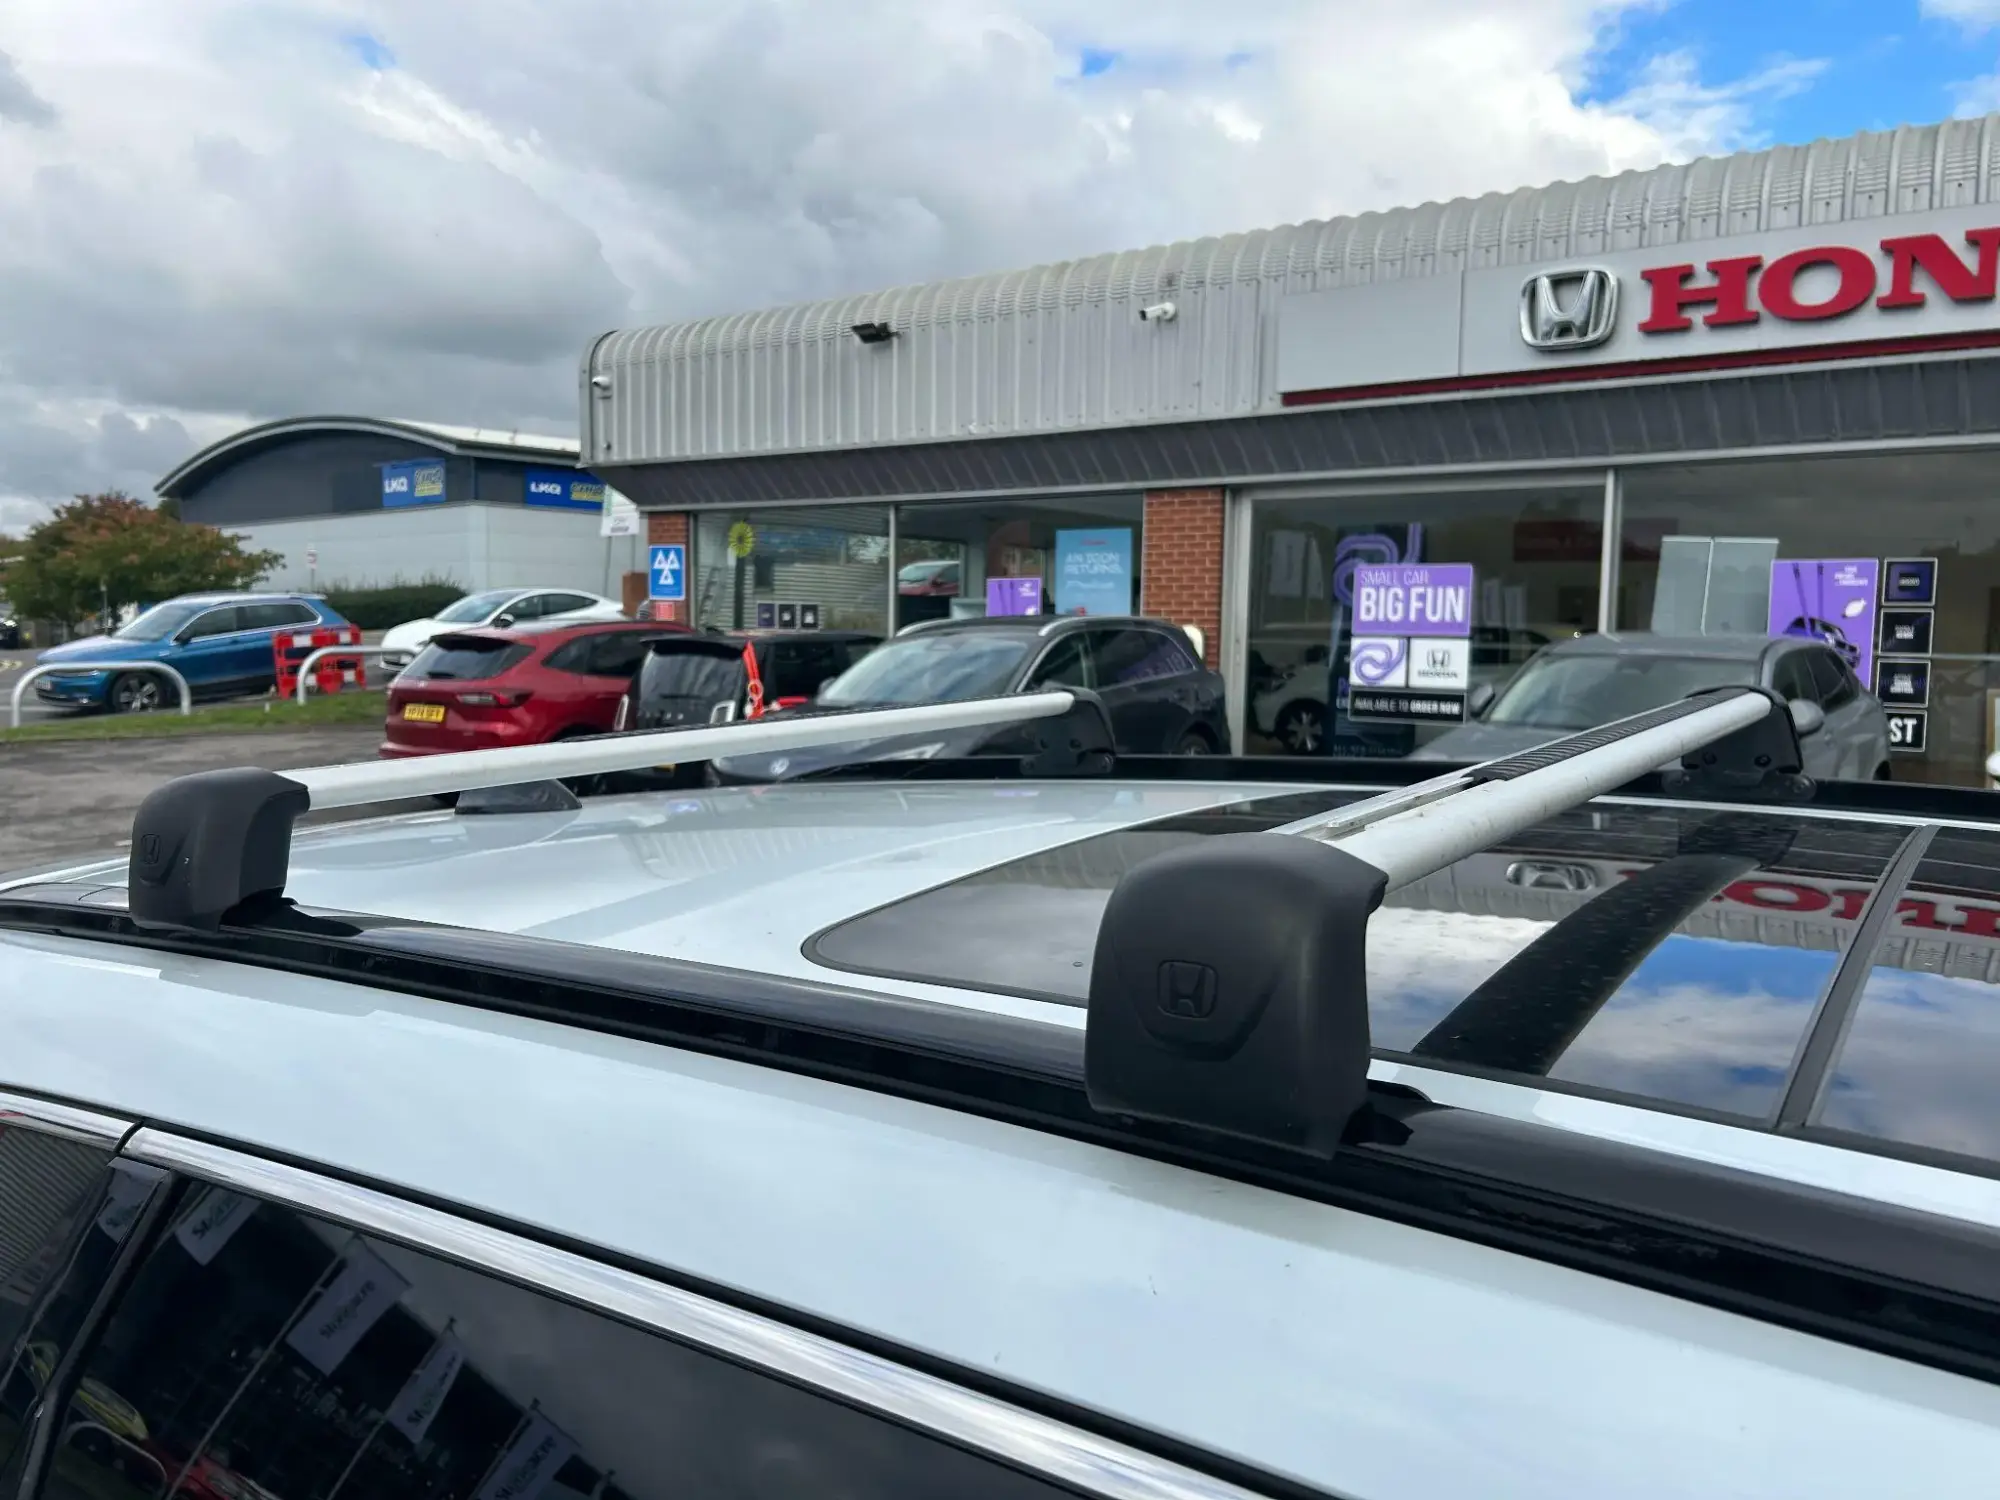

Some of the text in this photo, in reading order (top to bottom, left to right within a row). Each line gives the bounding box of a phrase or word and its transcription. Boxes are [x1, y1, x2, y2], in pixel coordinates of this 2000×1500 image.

[1638, 228, 2000, 332] HON
[385, 476, 408, 493] LKQ
[530, 481, 562, 495] LKQ
[1360, 569, 1398, 585] SMALL
[1360, 586, 1465, 622] BIG FUN
[1410, 700, 1438, 713] ORDER
[1440, 702, 1460, 715] NOW
